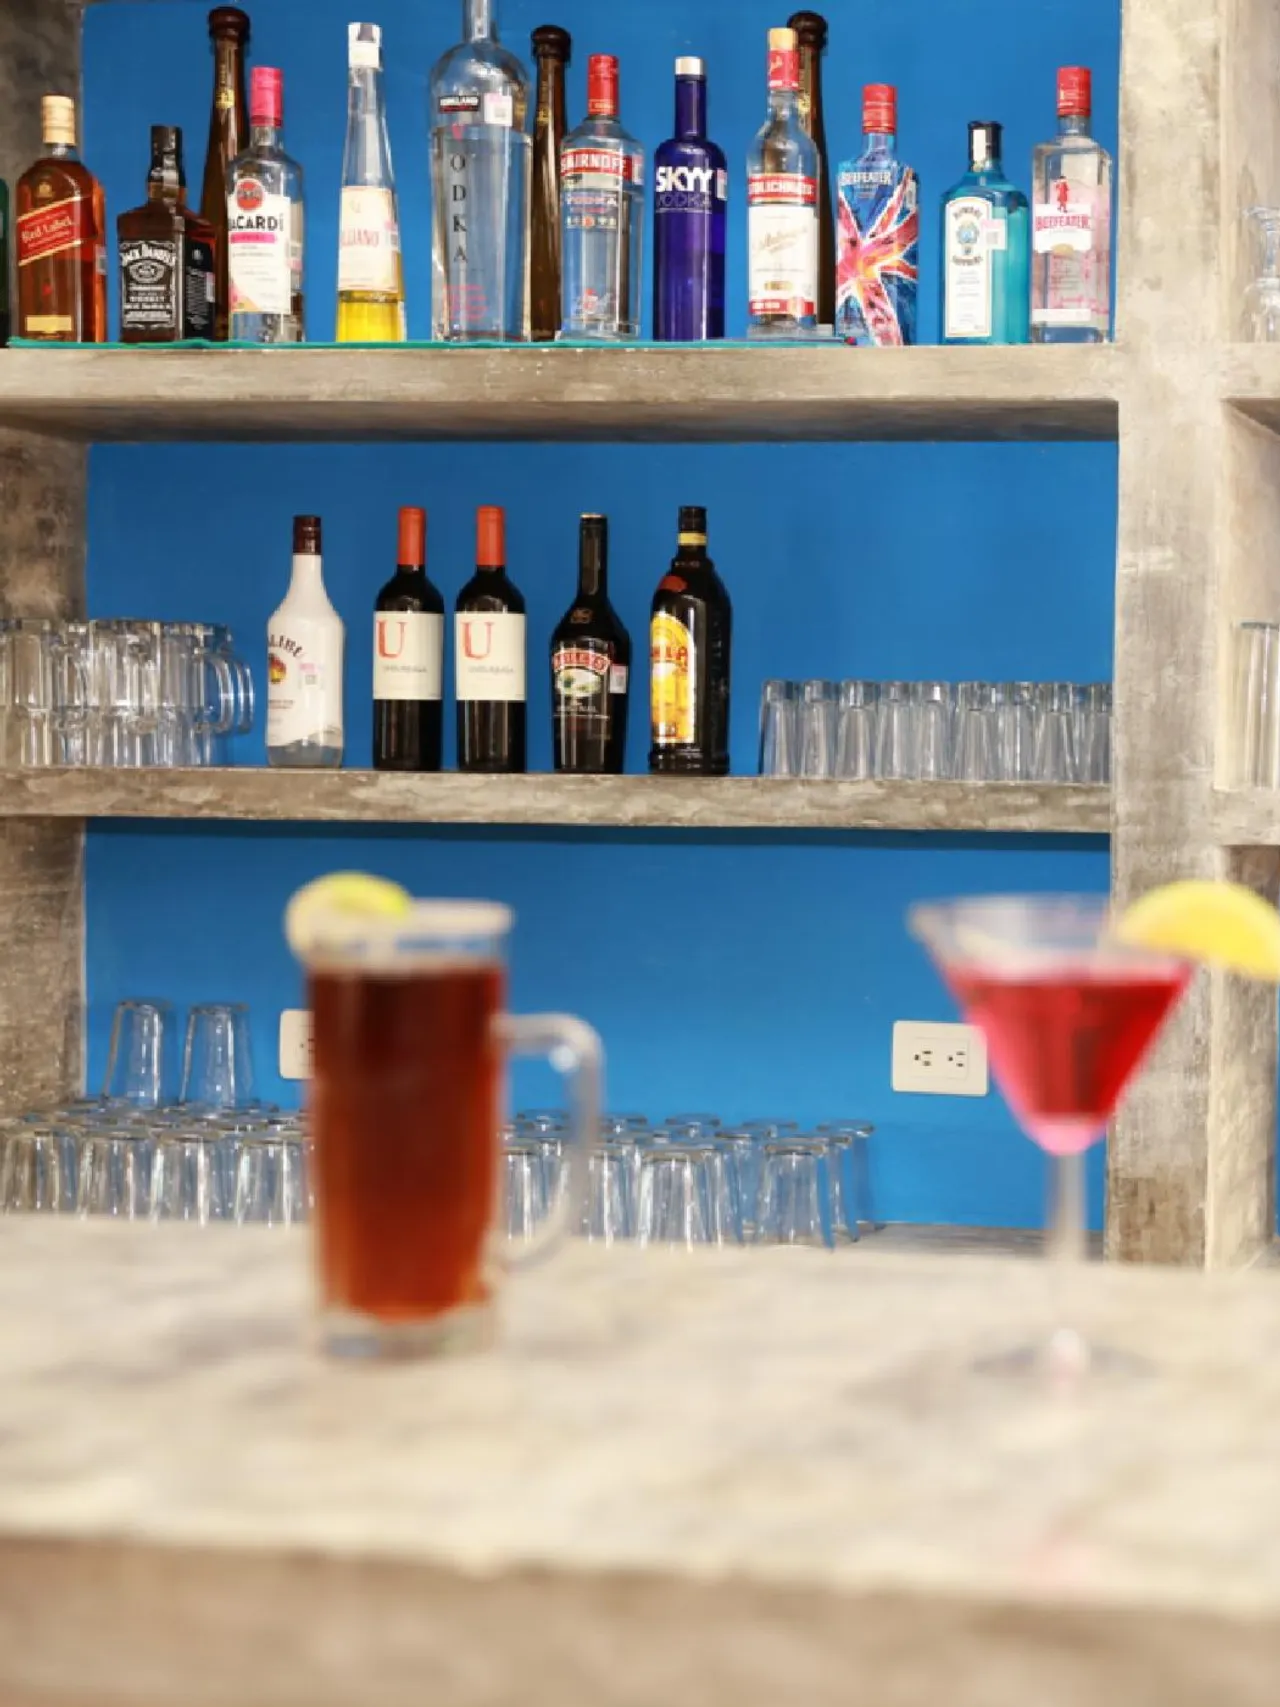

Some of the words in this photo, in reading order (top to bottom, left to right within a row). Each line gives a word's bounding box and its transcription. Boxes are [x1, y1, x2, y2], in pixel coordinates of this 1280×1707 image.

[655, 166, 713, 192] SKYY
[375, 619, 408, 659] U
[460, 621, 495, 660] U
